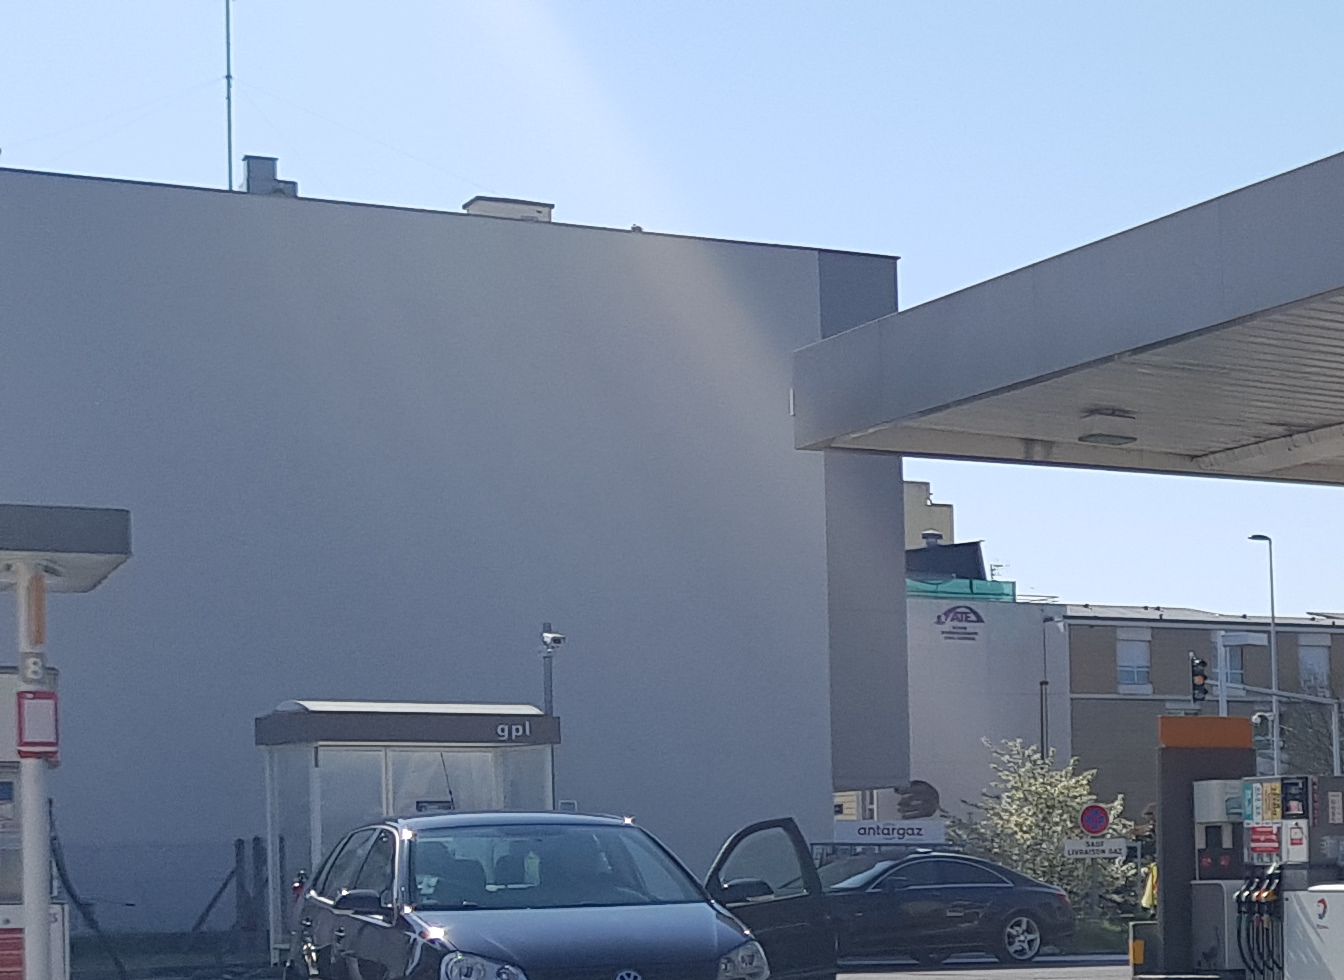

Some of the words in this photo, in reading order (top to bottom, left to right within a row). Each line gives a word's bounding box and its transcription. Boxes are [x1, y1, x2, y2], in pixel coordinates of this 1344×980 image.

[25, 657, 43, 680] 8
[496, 720, 531, 741] gpl
[857, 825, 924, 840] antargaz
